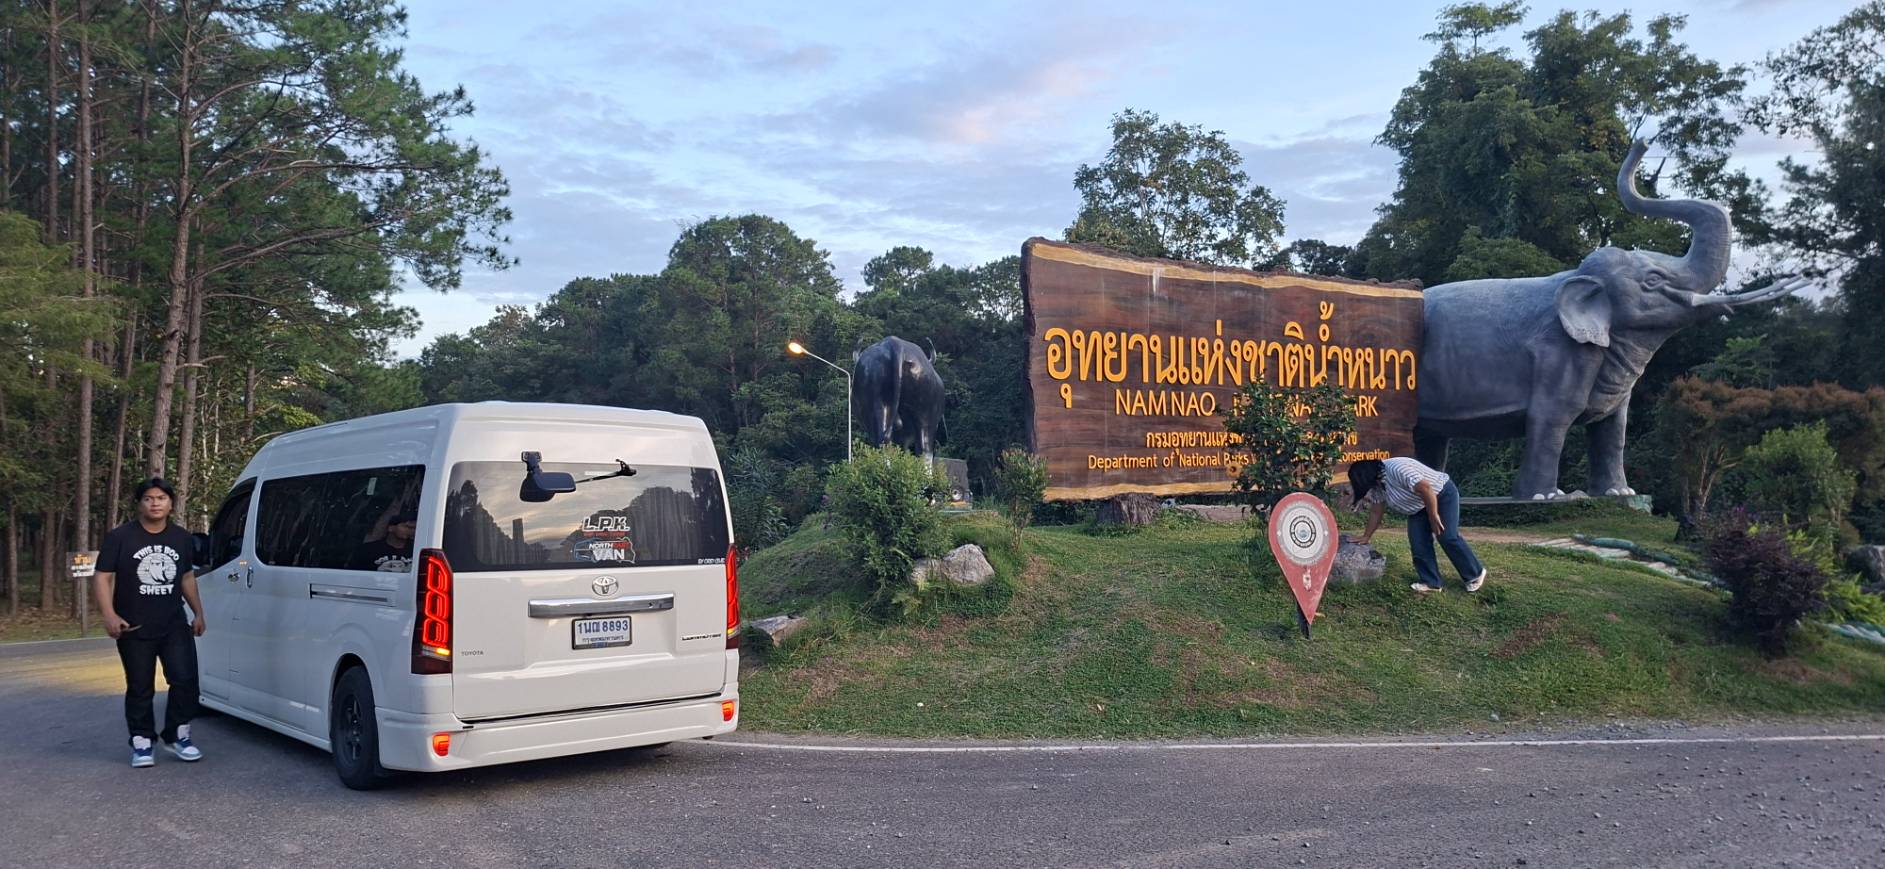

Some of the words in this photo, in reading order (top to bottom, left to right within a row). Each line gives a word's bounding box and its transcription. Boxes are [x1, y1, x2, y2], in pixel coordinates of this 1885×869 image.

[1043, 300, 1417, 408] อุทยานแห่งชาติน้ำหนาว
[1115, 388, 1167, 416] NAM
[1171, 391, 1216, 416] NAO
[1343, 395, 1379, 417] RK
[1088, 453, 1158, 472] Department
[1163, 451, 1175, 468] of
[1180, 450, 1220, 467] National
[1338, 447, 1390, 463] onservation
[133, 546, 153, 560] THIS
[154, 545, 162, 553] IS
[593, 549, 625, 560] VAN
[139, 584, 174, 595] SHEET
[602, 620, 628, 632] 8893
